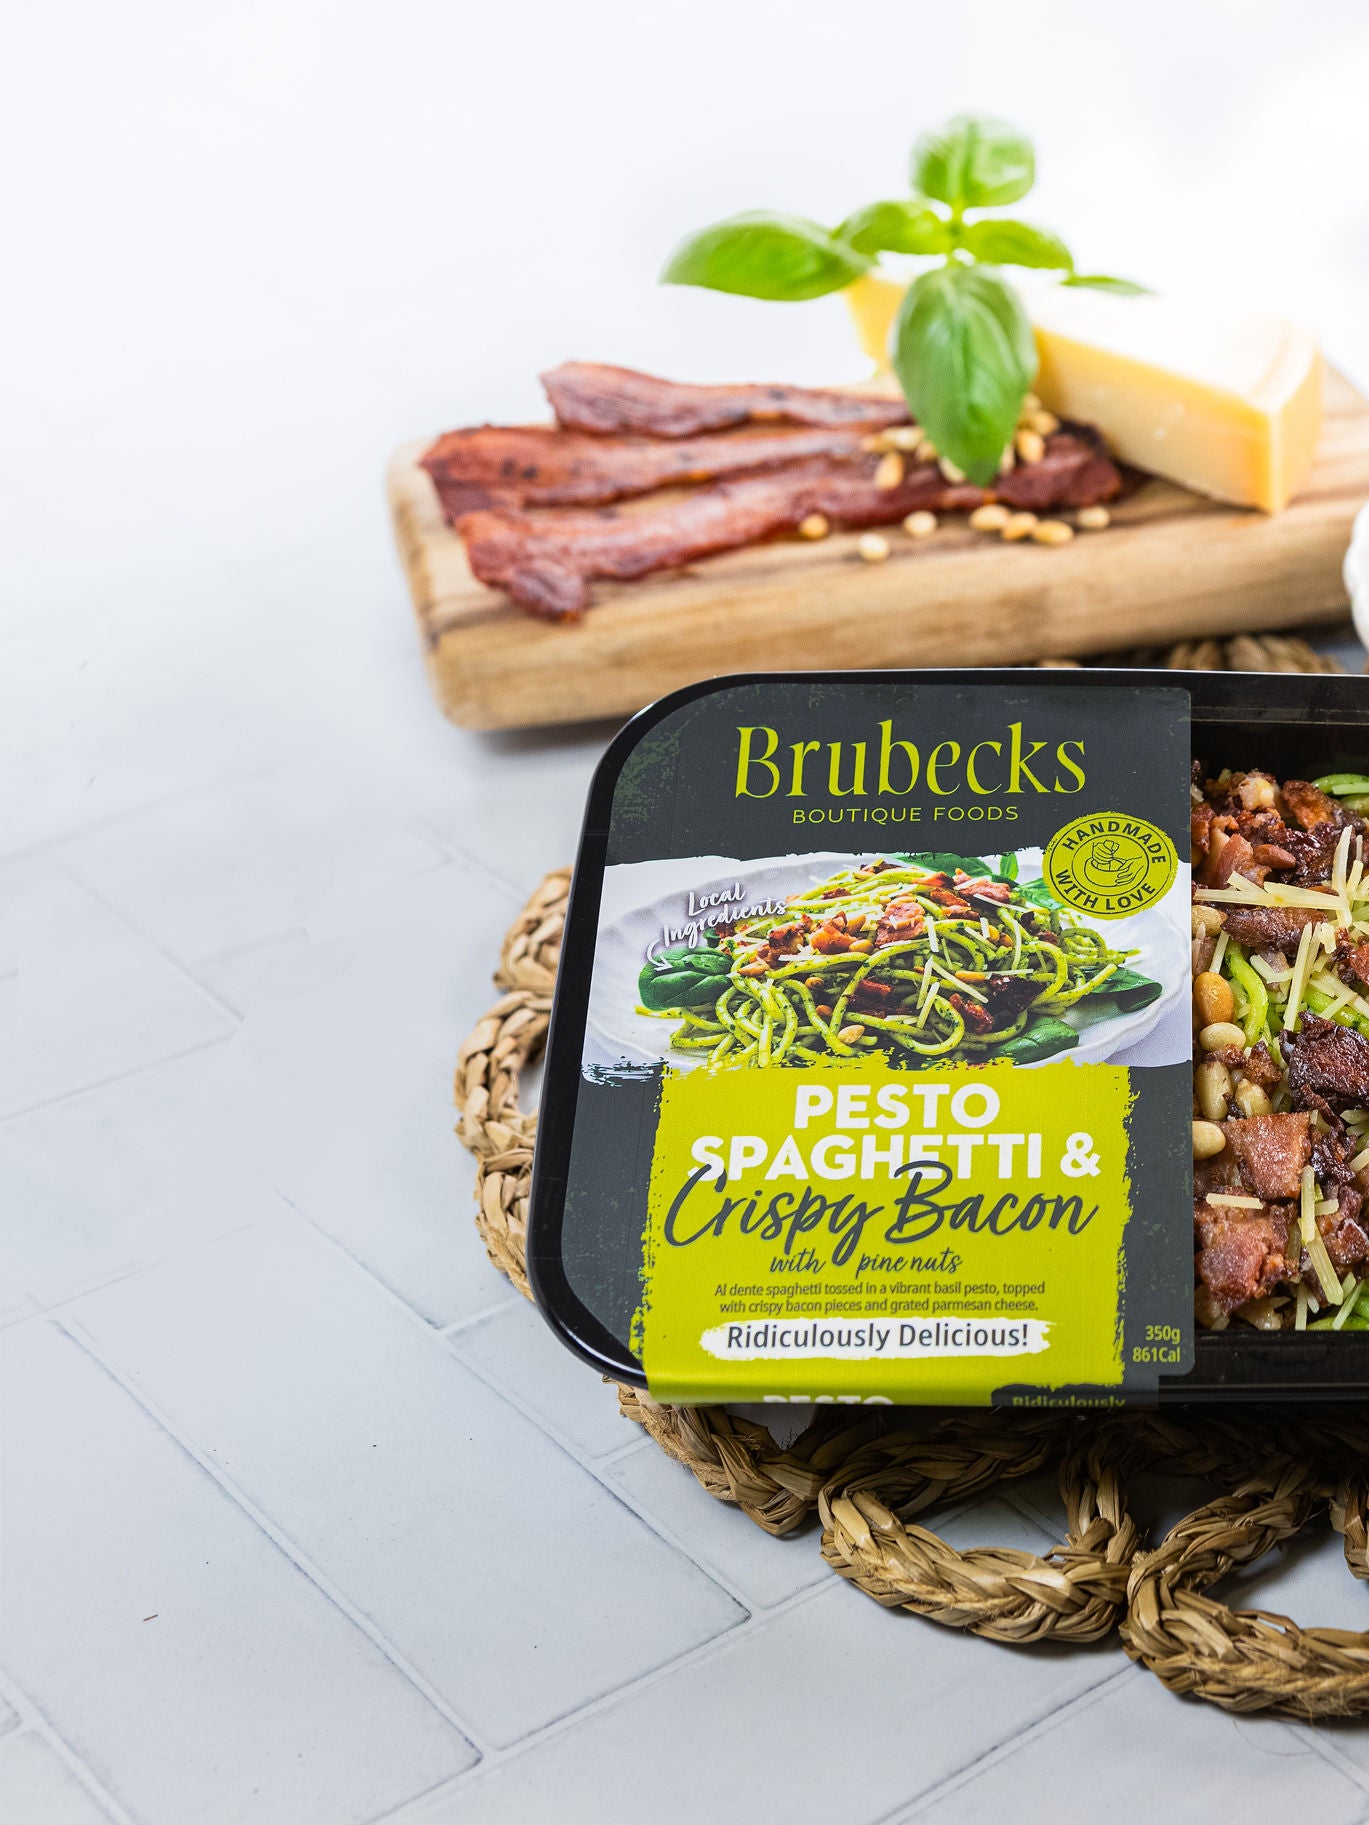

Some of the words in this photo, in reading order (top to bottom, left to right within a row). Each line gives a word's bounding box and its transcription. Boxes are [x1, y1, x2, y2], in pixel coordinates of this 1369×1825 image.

[735, 719, 1086, 799] Brubecks
[792, 807, 922, 825] BOUTIQUE
[933, 806, 1019, 821] FOODS
[1062, 821, 1166, 864] HANDMADE
[688, 882, 746, 917] Local
[1056, 869, 1099, 908] WITH
[1105, 883, 1156, 910] LOVE
[664, 897, 787, 949] Ingredients
[793, 1083, 1000, 1129] PESTO
[687, 1132, 1042, 1181] SPAGHETTI
[1060, 1132, 1101, 1178] &
[664, 1163, 885, 1267] Crispy
[885, 1160, 1099, 1244] Bacon
[769, 1247, 826, 1273] with
[855, 1253, 907, 1279] pine
[910, 1247, 963, 1273] nuts
[715, 1284, 726, 1296] Al
[729, 1284, 763, 1296] dente
[765, 1282, 822, 1298] spaghetti
[824, 1281, 862, 1295] tossed
[866, 1281, 877, 1294] in
[879, 1284, 887, 1294] a
[889, 1281, 931, 1294] vibrant
[934, 1281, 961, 1294] basil
[964, 1283, 1000, 1297] pesto,
[1003, 1281, 1045, 1297] topped
[720, 1300, 746, 1313] with
[749, 1300, 783, 1315] crispy
[785, 1299, 822, 1312] bacon
[824, 1299, 862, 1314] pieces
[864, 1299, 888, 1311] and
[890, 1298, 929, 1314] grated
[932, 1300, 992, 1313] parmesan
[994, 1298, 1039, 1311] cheese.
[727, 1323, 891, 1351] Ridiculously
[899, 1323, 1028, 1347] Delicious!
[1145, 1325, 1181, 1344] 350g
[1132, 1346, 1181, 1363] 861Cal
